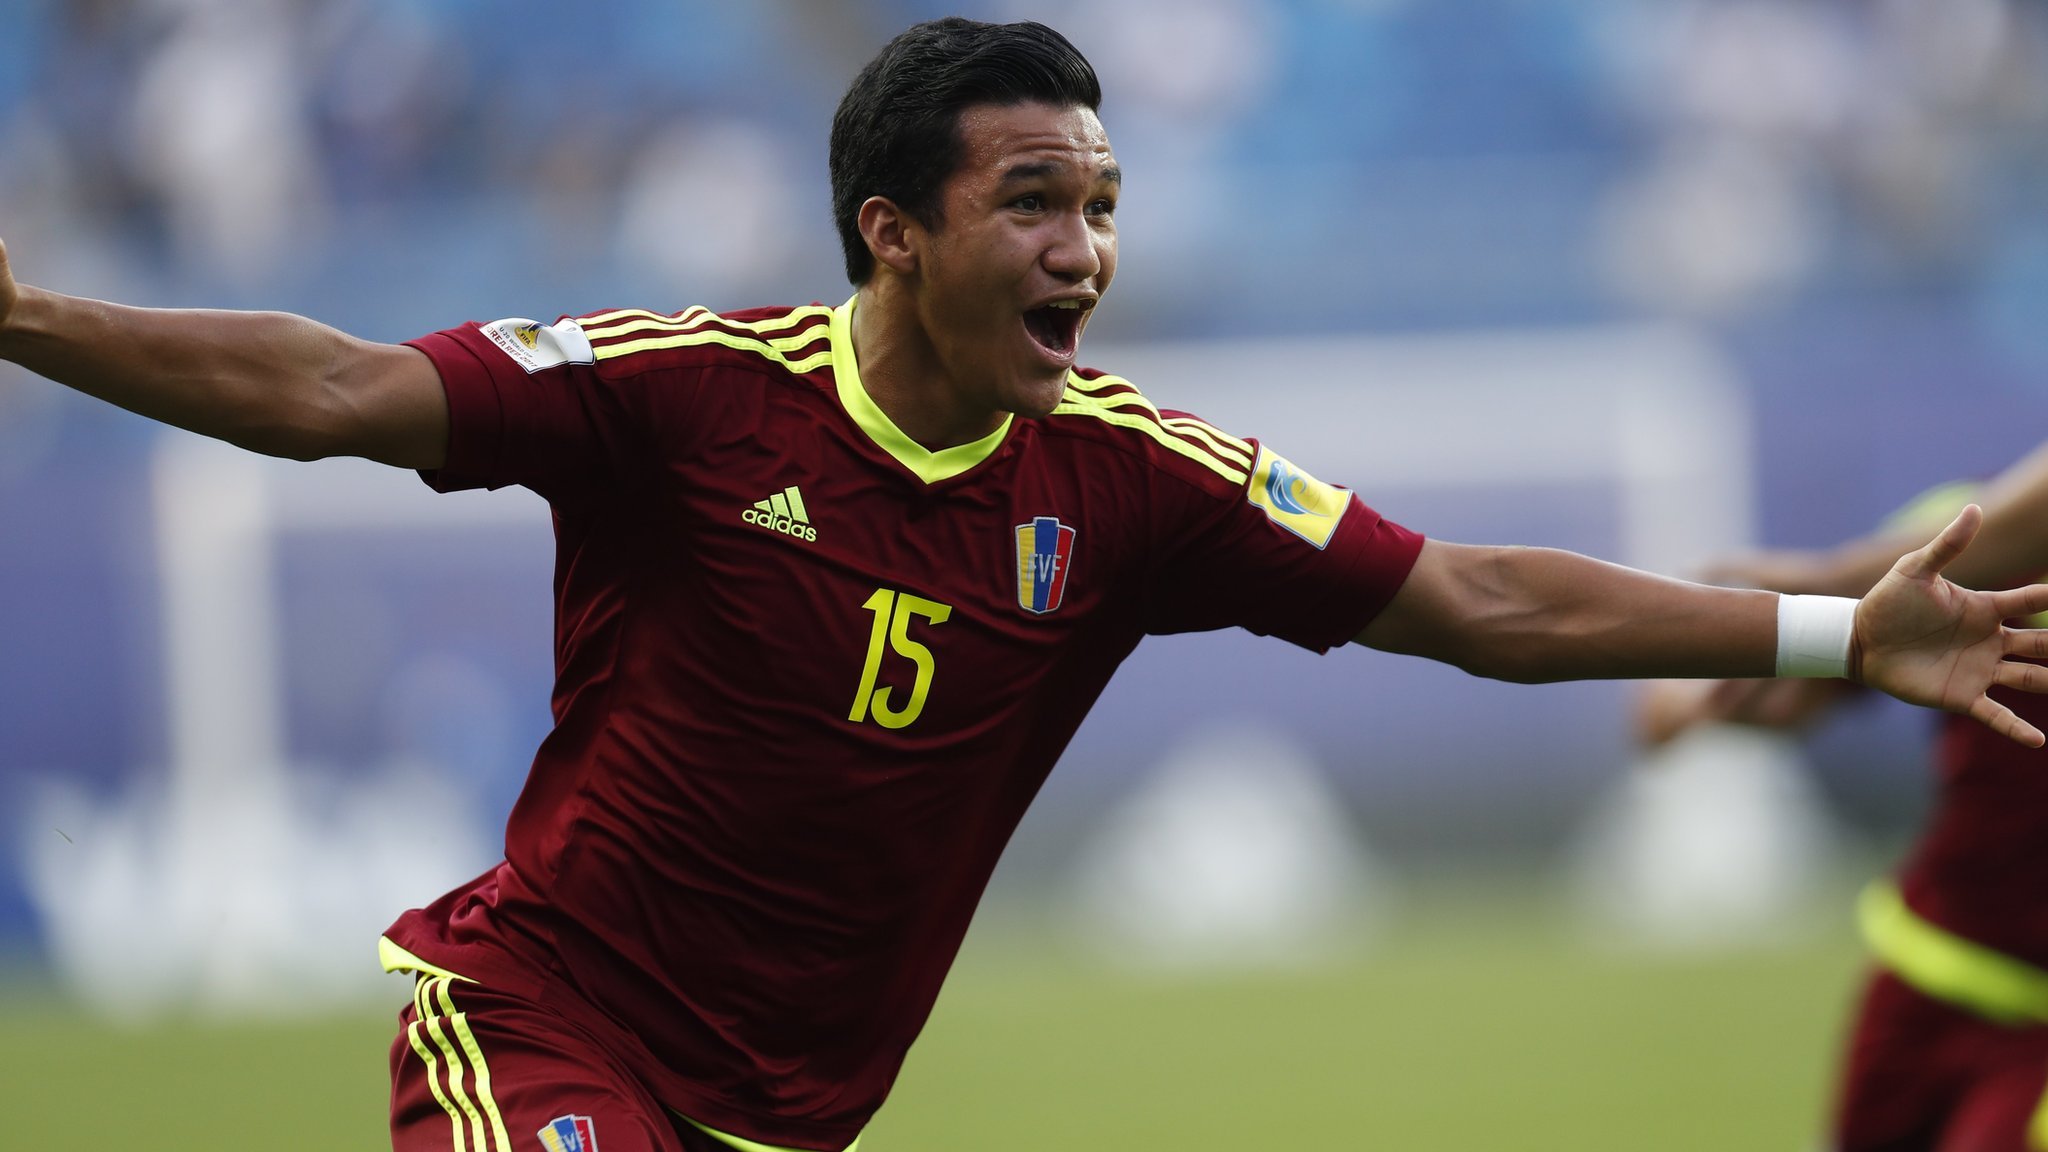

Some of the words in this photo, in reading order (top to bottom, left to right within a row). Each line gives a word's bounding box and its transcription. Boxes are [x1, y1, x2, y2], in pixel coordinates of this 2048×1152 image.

[509, 338, 524, 353] WORLD
[520, 333, 531, 345] FIFA
[742, 509, 817, 542] adidas
[1026, 553, 1062, 583] FVF
[848, 588, 952, 729] 15
